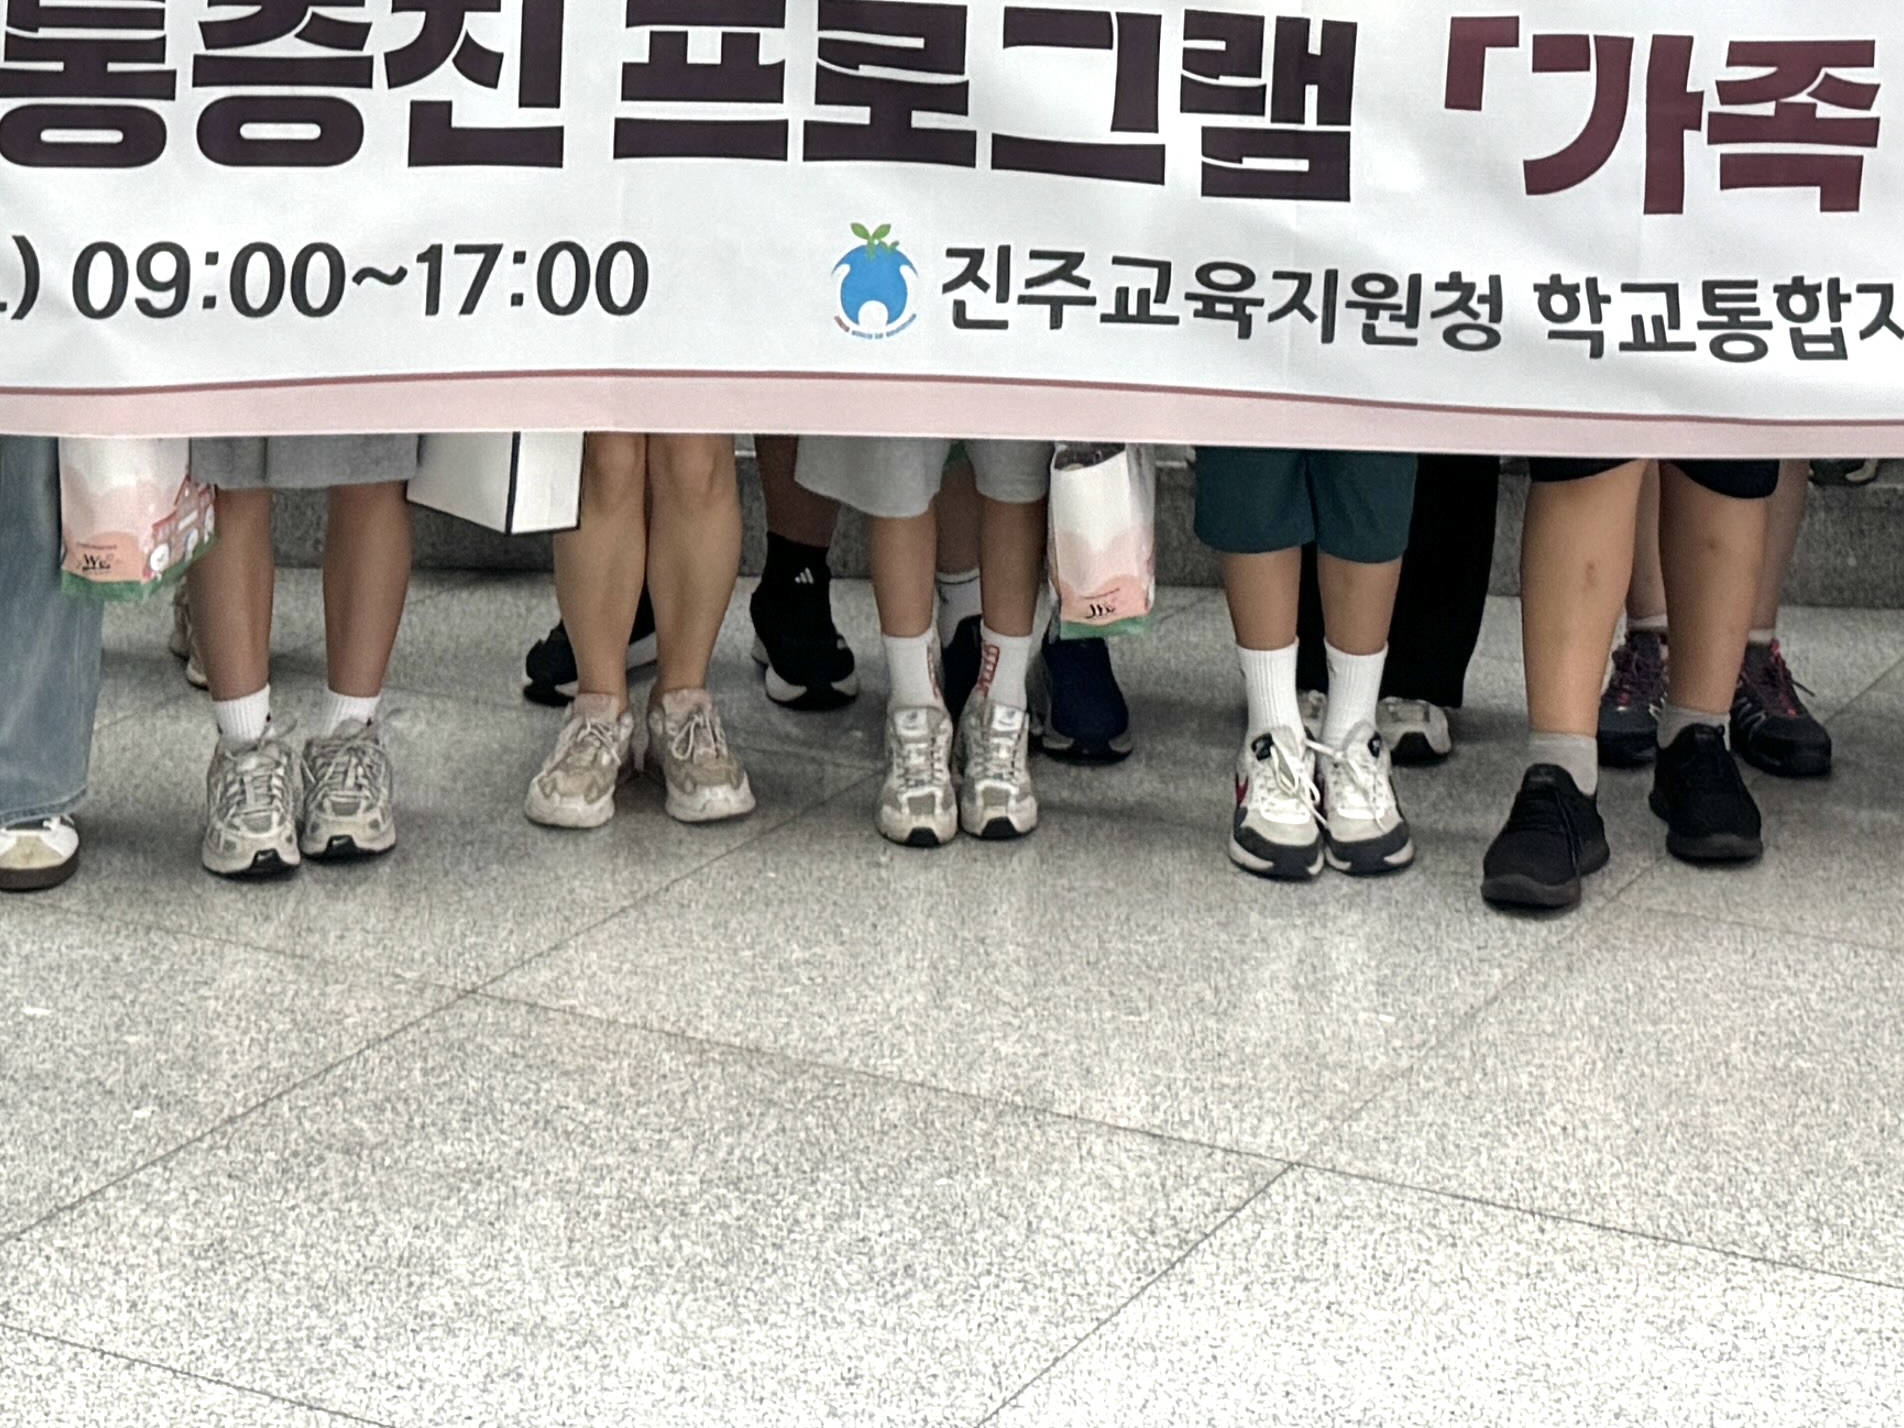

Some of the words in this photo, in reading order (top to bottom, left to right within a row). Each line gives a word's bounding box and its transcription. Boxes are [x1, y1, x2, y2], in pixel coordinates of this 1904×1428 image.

[1444, 15, 1881, 216] 「가족
[71, 240, 649, 320] 09:00~17:00
[941, 244, 1503, 352] 진주교육지원청
